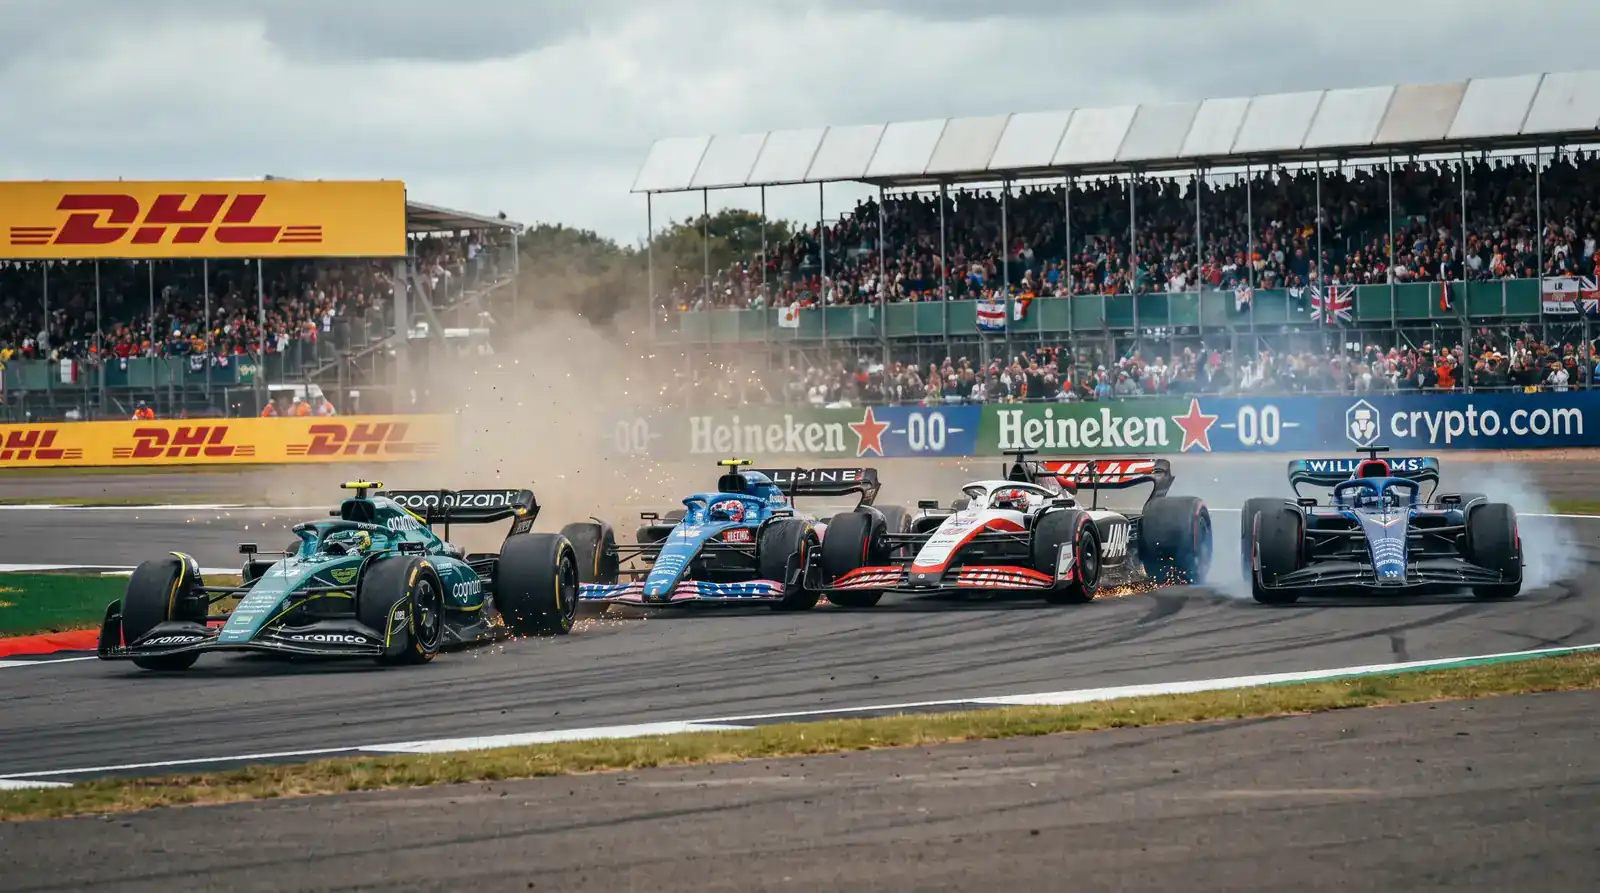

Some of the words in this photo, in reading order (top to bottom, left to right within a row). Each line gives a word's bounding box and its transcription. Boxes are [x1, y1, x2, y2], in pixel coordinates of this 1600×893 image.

[53, 194, 282, 245] DHL
[306, 422, 416, 457] DHL
[689, 414, 847, 454] Heineken
[997, 407, 1170, 449] Heineken
[1390, 404, 1584, 444] crypto.com
[0, 430, 65, 460] HL
[132, 426, 235, 458] DHL
[1310, 459, 1419, 472] WILLMS
[143, 635, 204, 646] aramco
[291, 634, 367, 645] aramco
